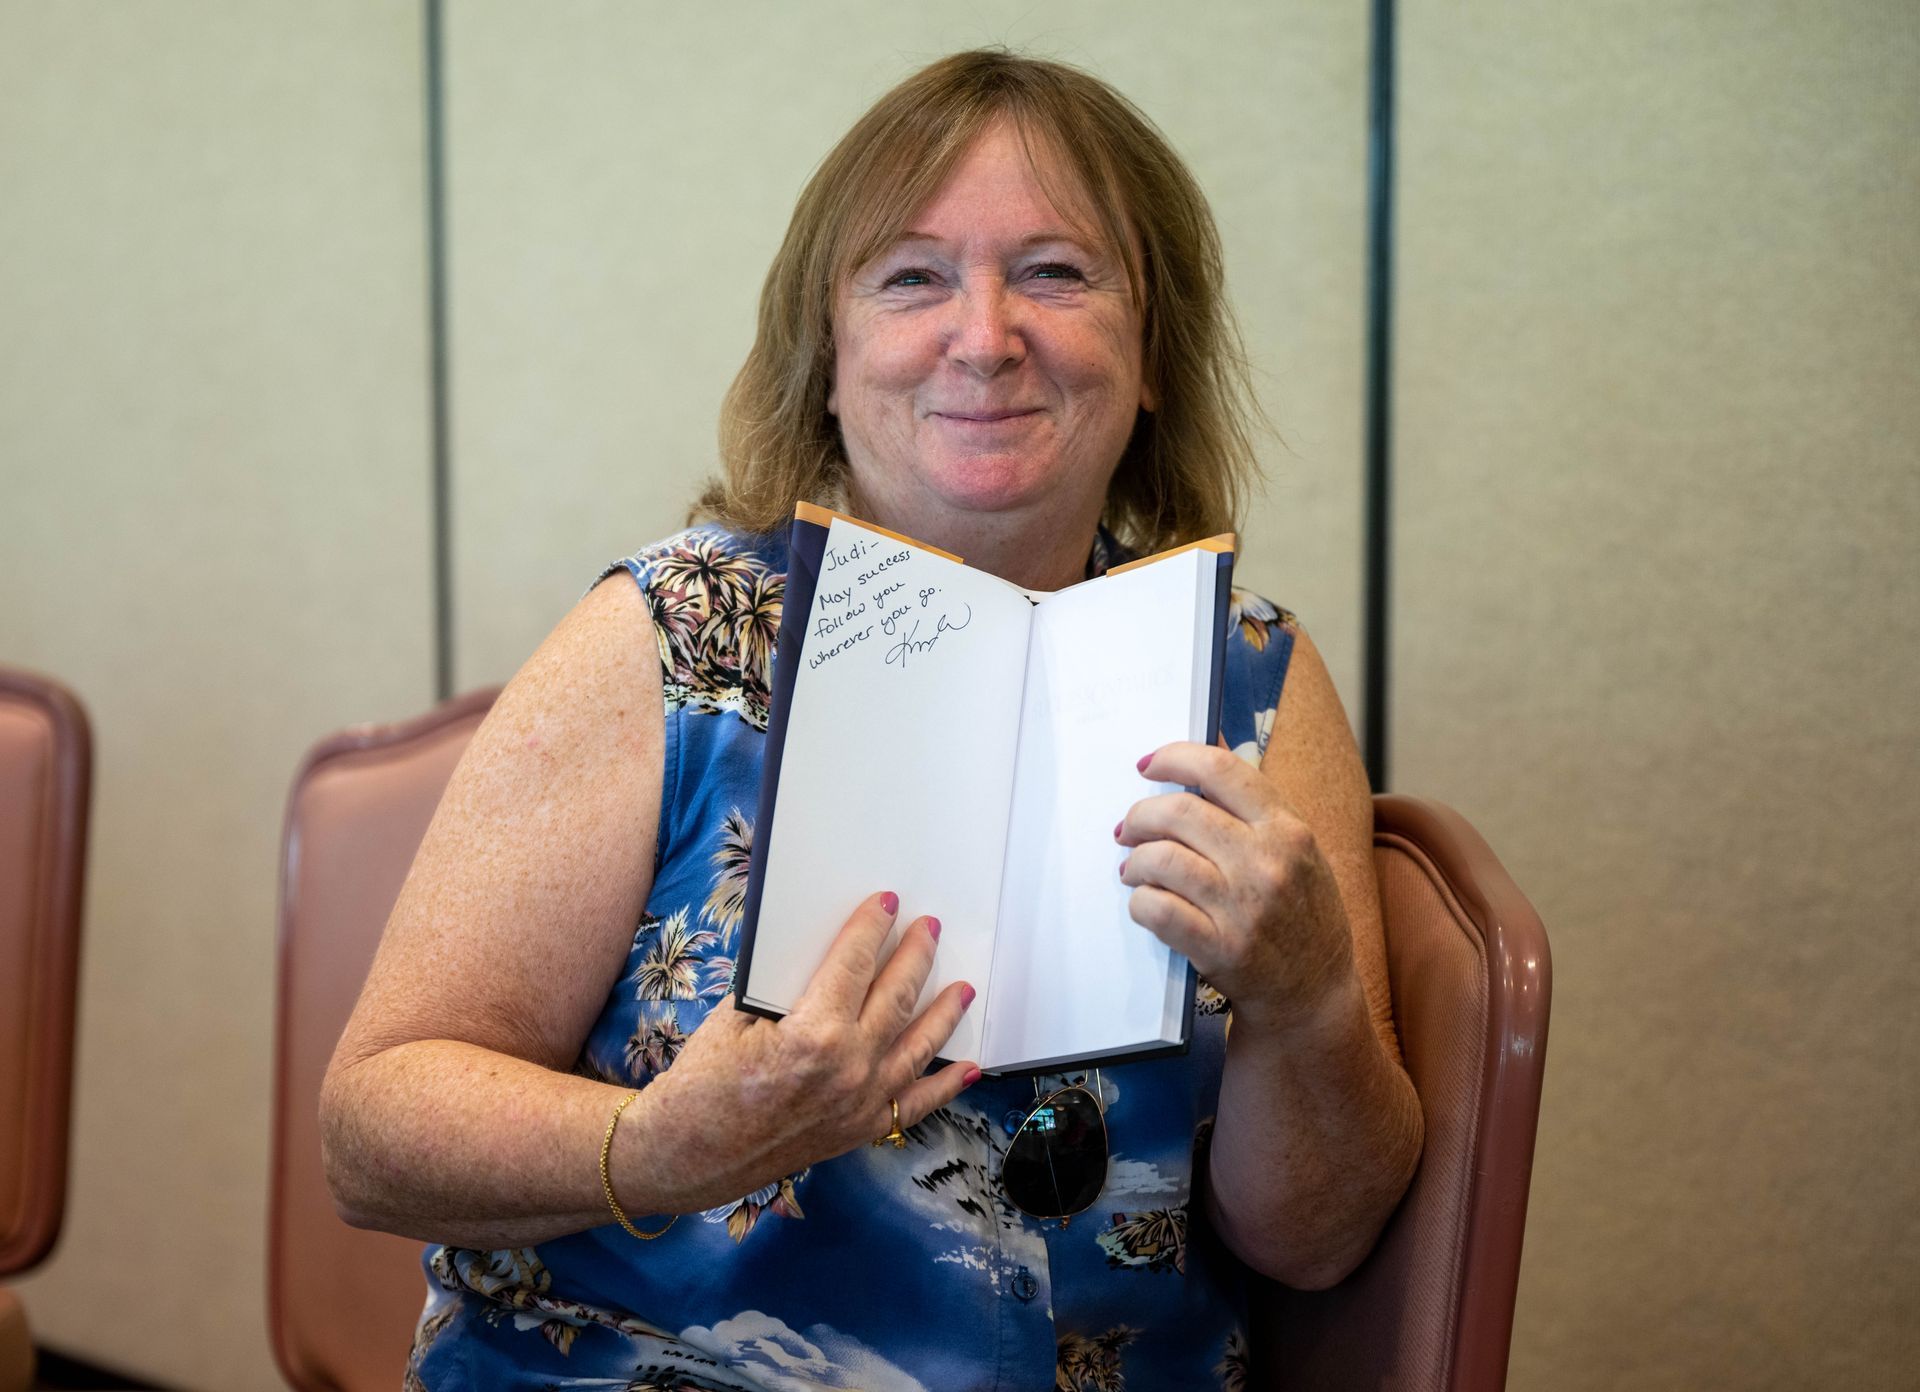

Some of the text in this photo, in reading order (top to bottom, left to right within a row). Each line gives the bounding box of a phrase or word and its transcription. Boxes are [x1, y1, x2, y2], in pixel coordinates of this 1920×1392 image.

[819, 551, 910, 610] May success
[809, 626, 874, 669] wherever
[881, 605, 911, 635] you
[918, 588, 942, 607] go.
[814, 603, 866, 638] follow
[872, 583, 905, 609] you
